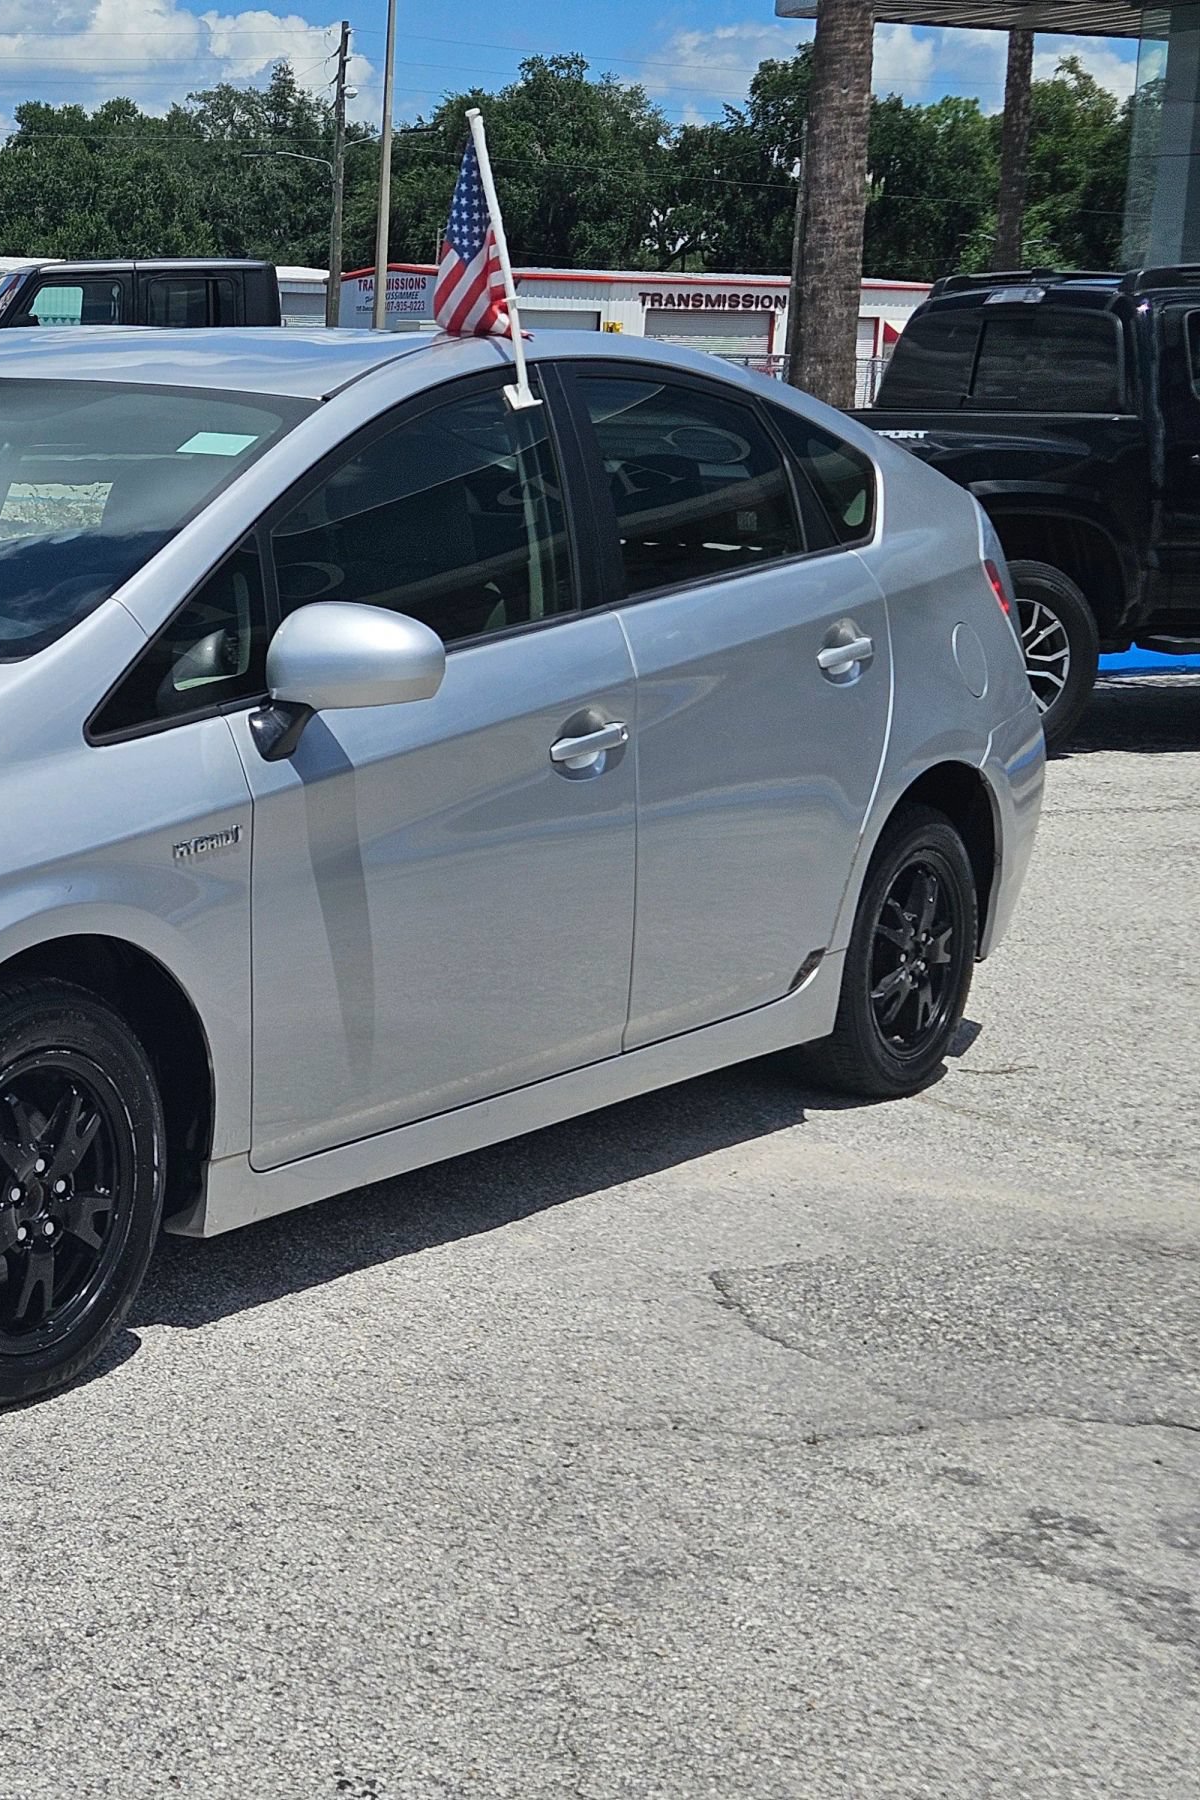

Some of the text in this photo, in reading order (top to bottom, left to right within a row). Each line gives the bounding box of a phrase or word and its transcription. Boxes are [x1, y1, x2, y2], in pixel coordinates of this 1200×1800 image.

[358, 277, 427, 292] TRAMISSIONS
[385, 301, 425, 312] 07-935-0223
[638, 292, 787, 309] TRANSMISSION
[873, 430, 929, 439] PORT
[173, 829, 237, 860] HYBRID
